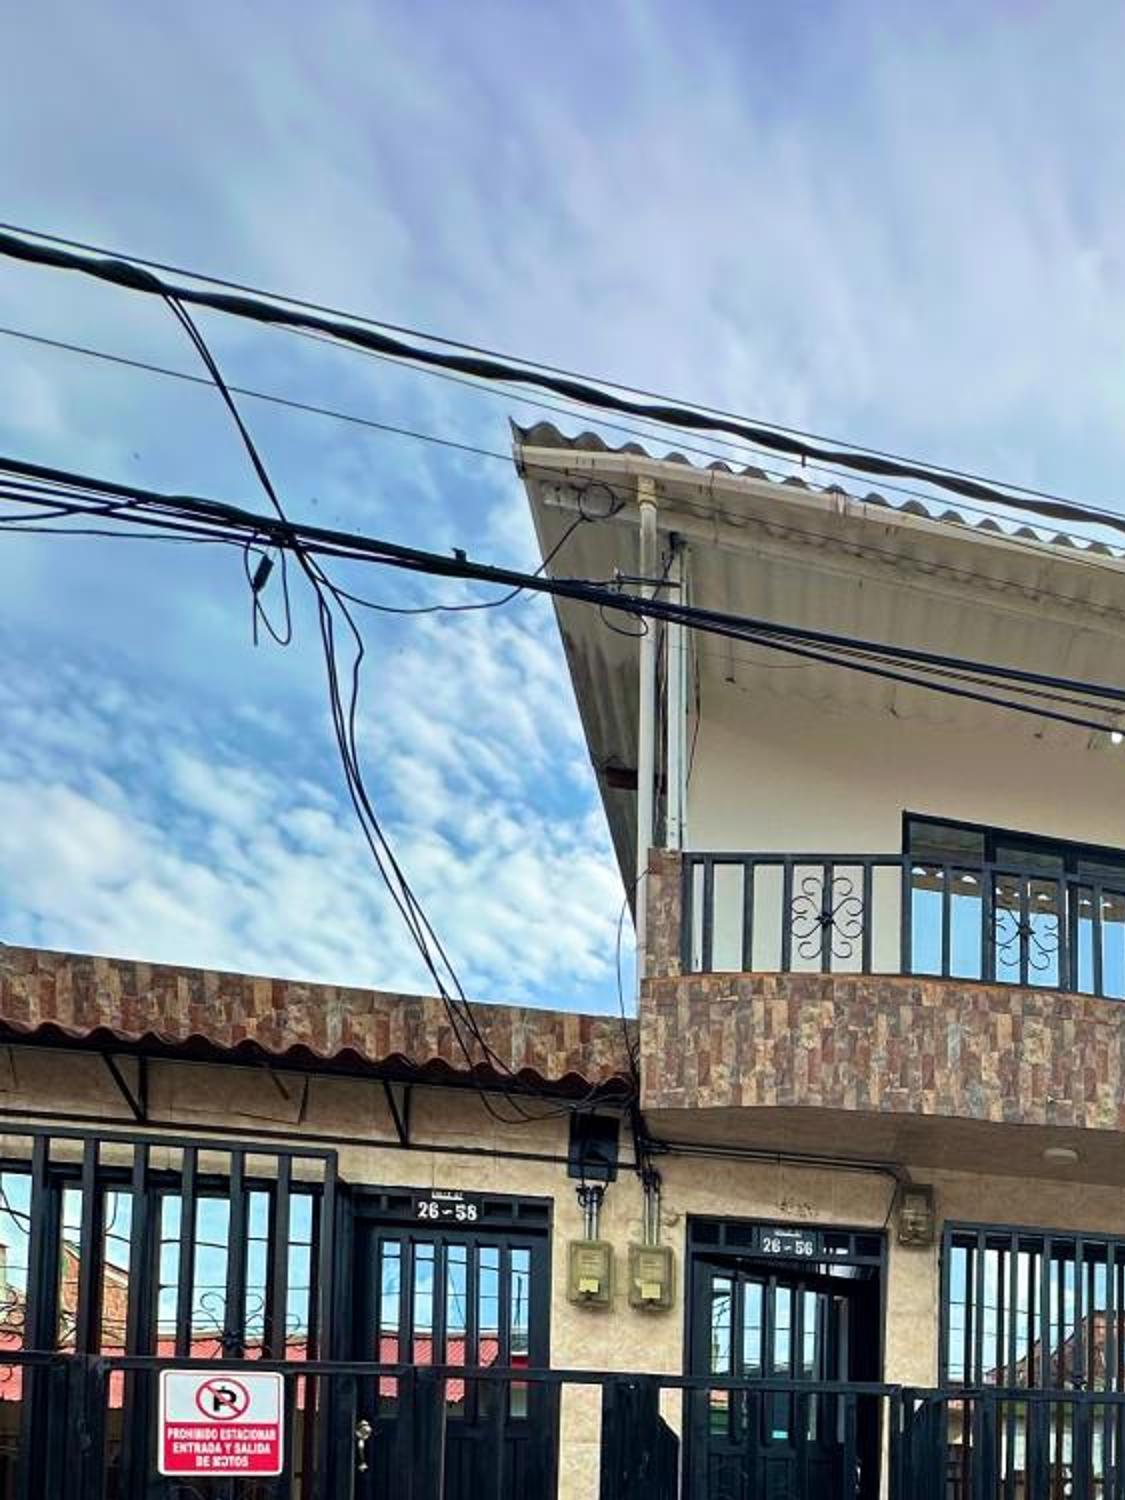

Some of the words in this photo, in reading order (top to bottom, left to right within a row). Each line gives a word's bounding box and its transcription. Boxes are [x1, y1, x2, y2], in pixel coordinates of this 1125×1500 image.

[418, 1201, 477, 1220] 26-58
[167, 1427, 218, 1440] PROHIBIDO
[220, 1428, 277, 1440] ESTACIONAR
[173, 1442, 222, 1454] ENTRADA
[224, 1443, 232, 1454] Y
[234, 1443, 271, 1454] SALIDA
[196, 1455, 210, 1467] DE
[212, 1455, 249, 1467] MOTOS
